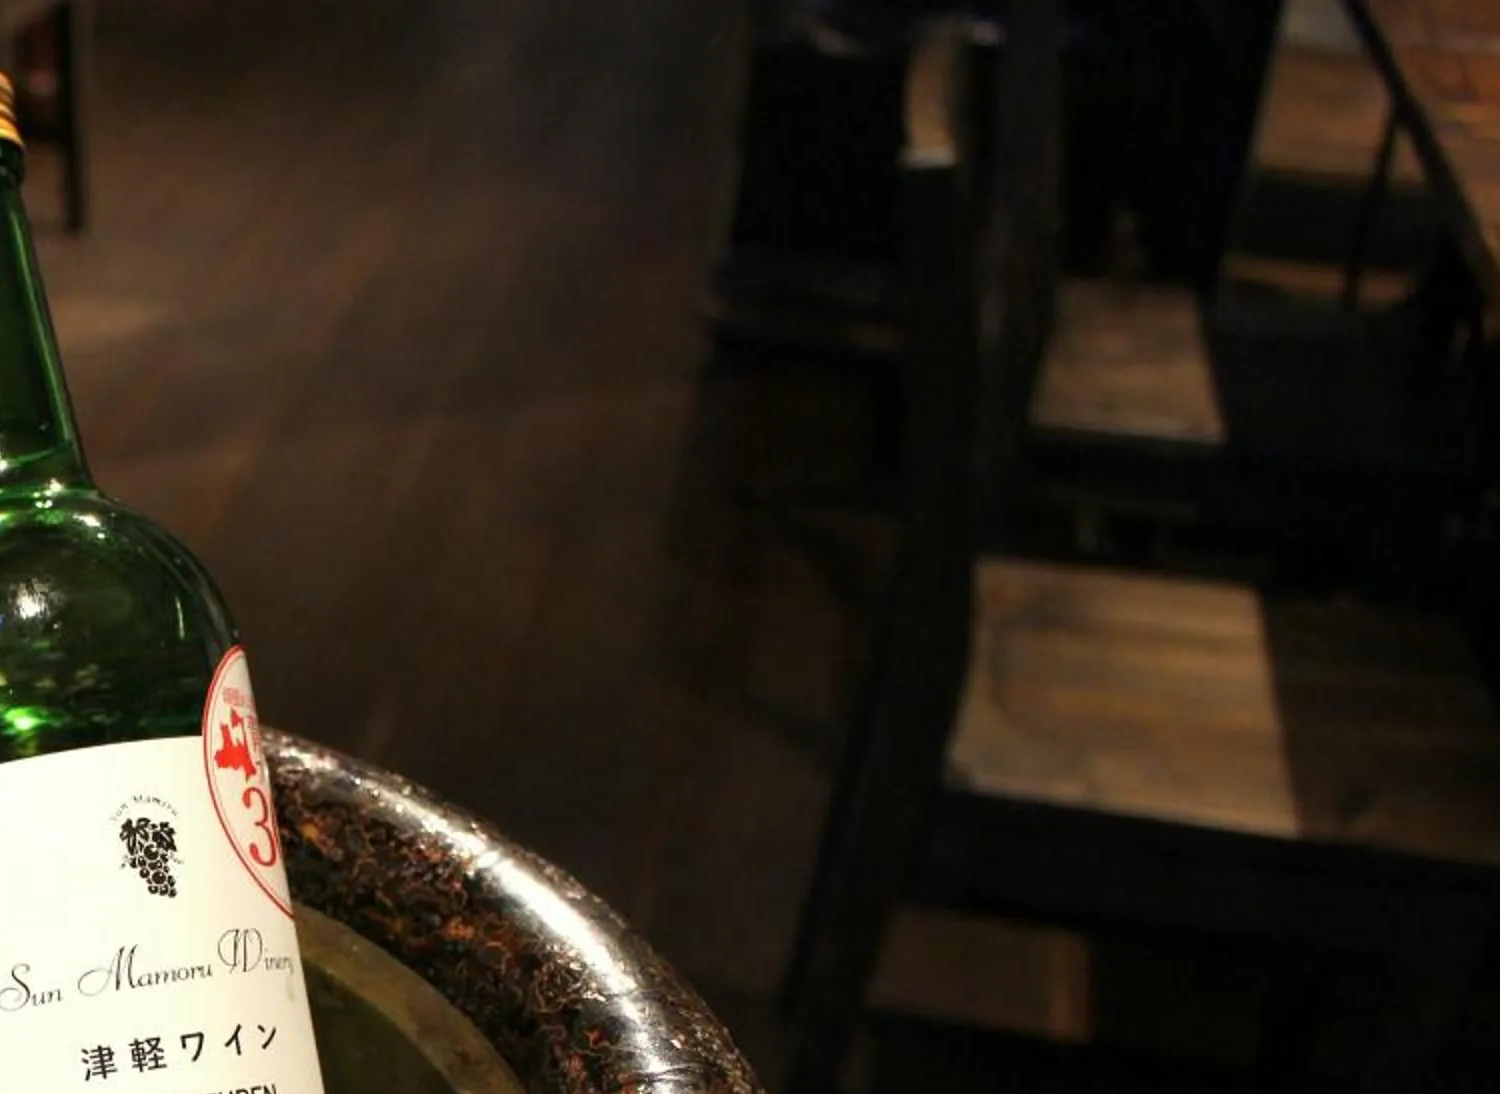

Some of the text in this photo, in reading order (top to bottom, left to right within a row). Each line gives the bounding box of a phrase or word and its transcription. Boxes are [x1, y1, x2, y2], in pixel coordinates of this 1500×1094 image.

[77, 944, 213, 997] Mamoru
[80, 1023, 277, 1082] 津軽ワイン
